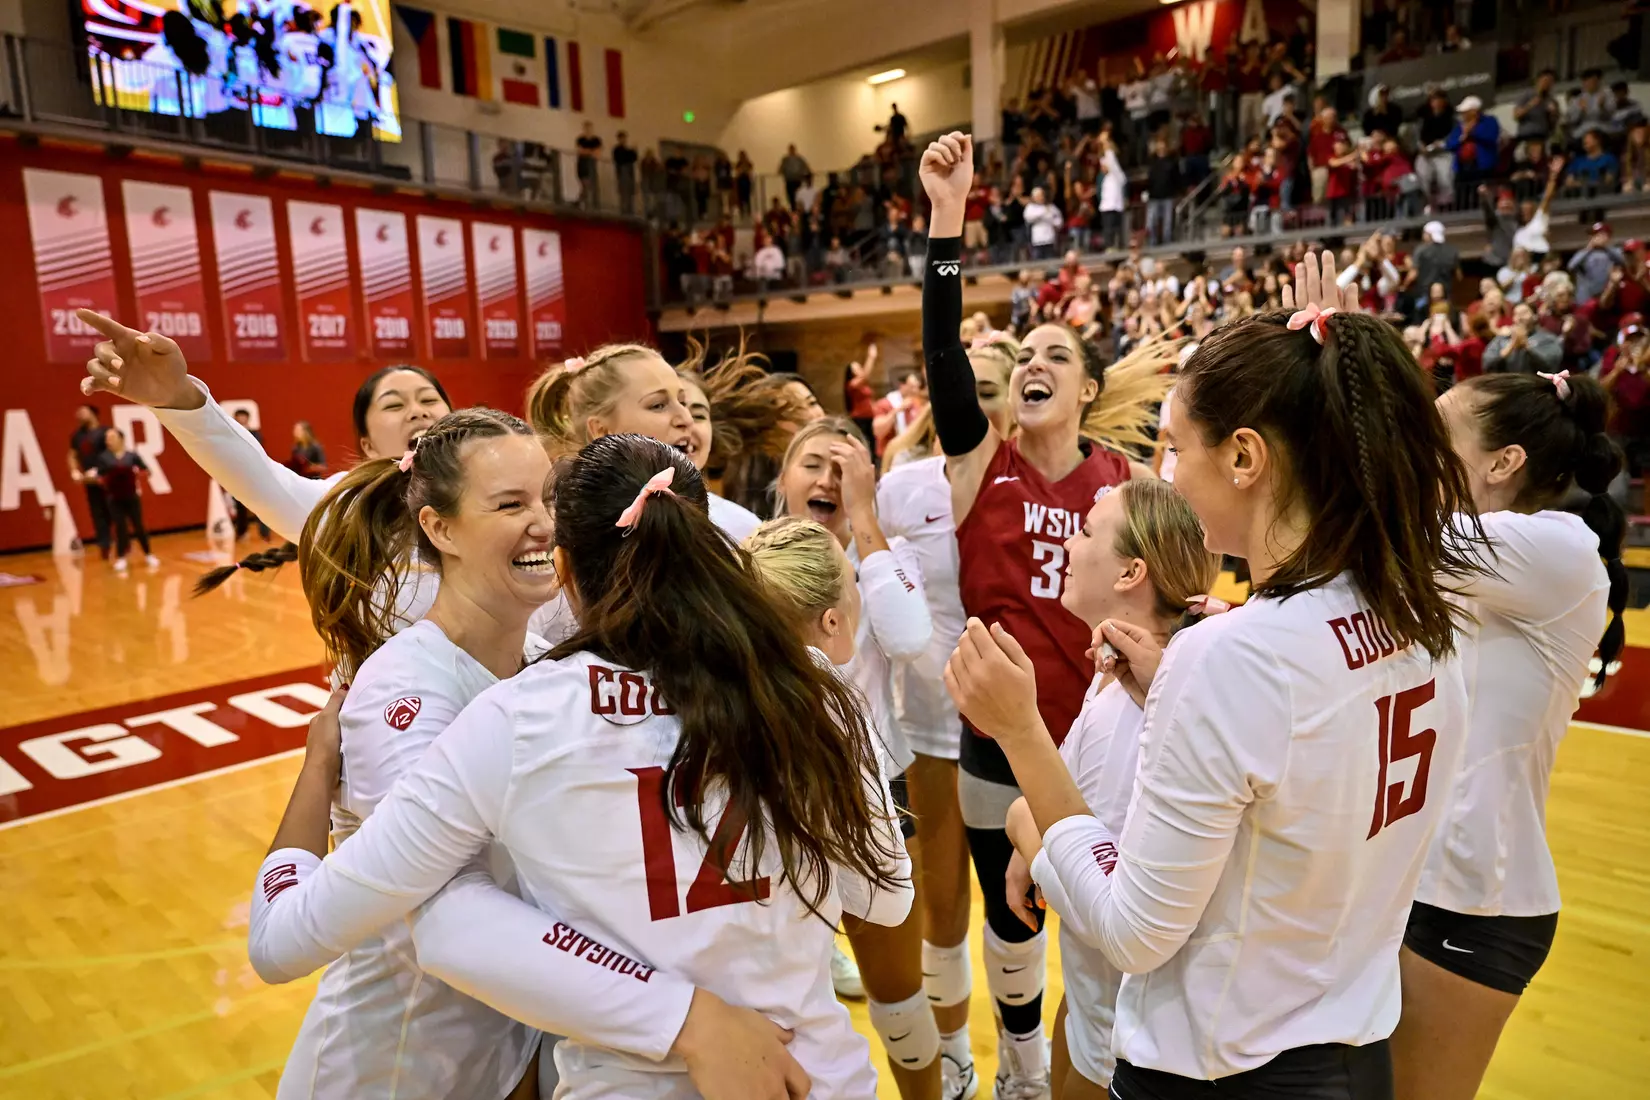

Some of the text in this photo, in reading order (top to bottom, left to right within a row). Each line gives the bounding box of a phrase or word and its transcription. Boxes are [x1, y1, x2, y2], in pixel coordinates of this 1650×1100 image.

[308, 314, 346, 337] 2017
[1023, 502, 1080, 539] WSU
[385, 698, 420, 723] PAC
[395, 713, 411, 727] 12
[1366, 677, 1437, 841] 15
[624, 766, 771, 921] 12
[1091, 842, 1118, 877] WSU
[263, 864, 299, 903] WSU
[542, 921, 656, 983] COUGARS
